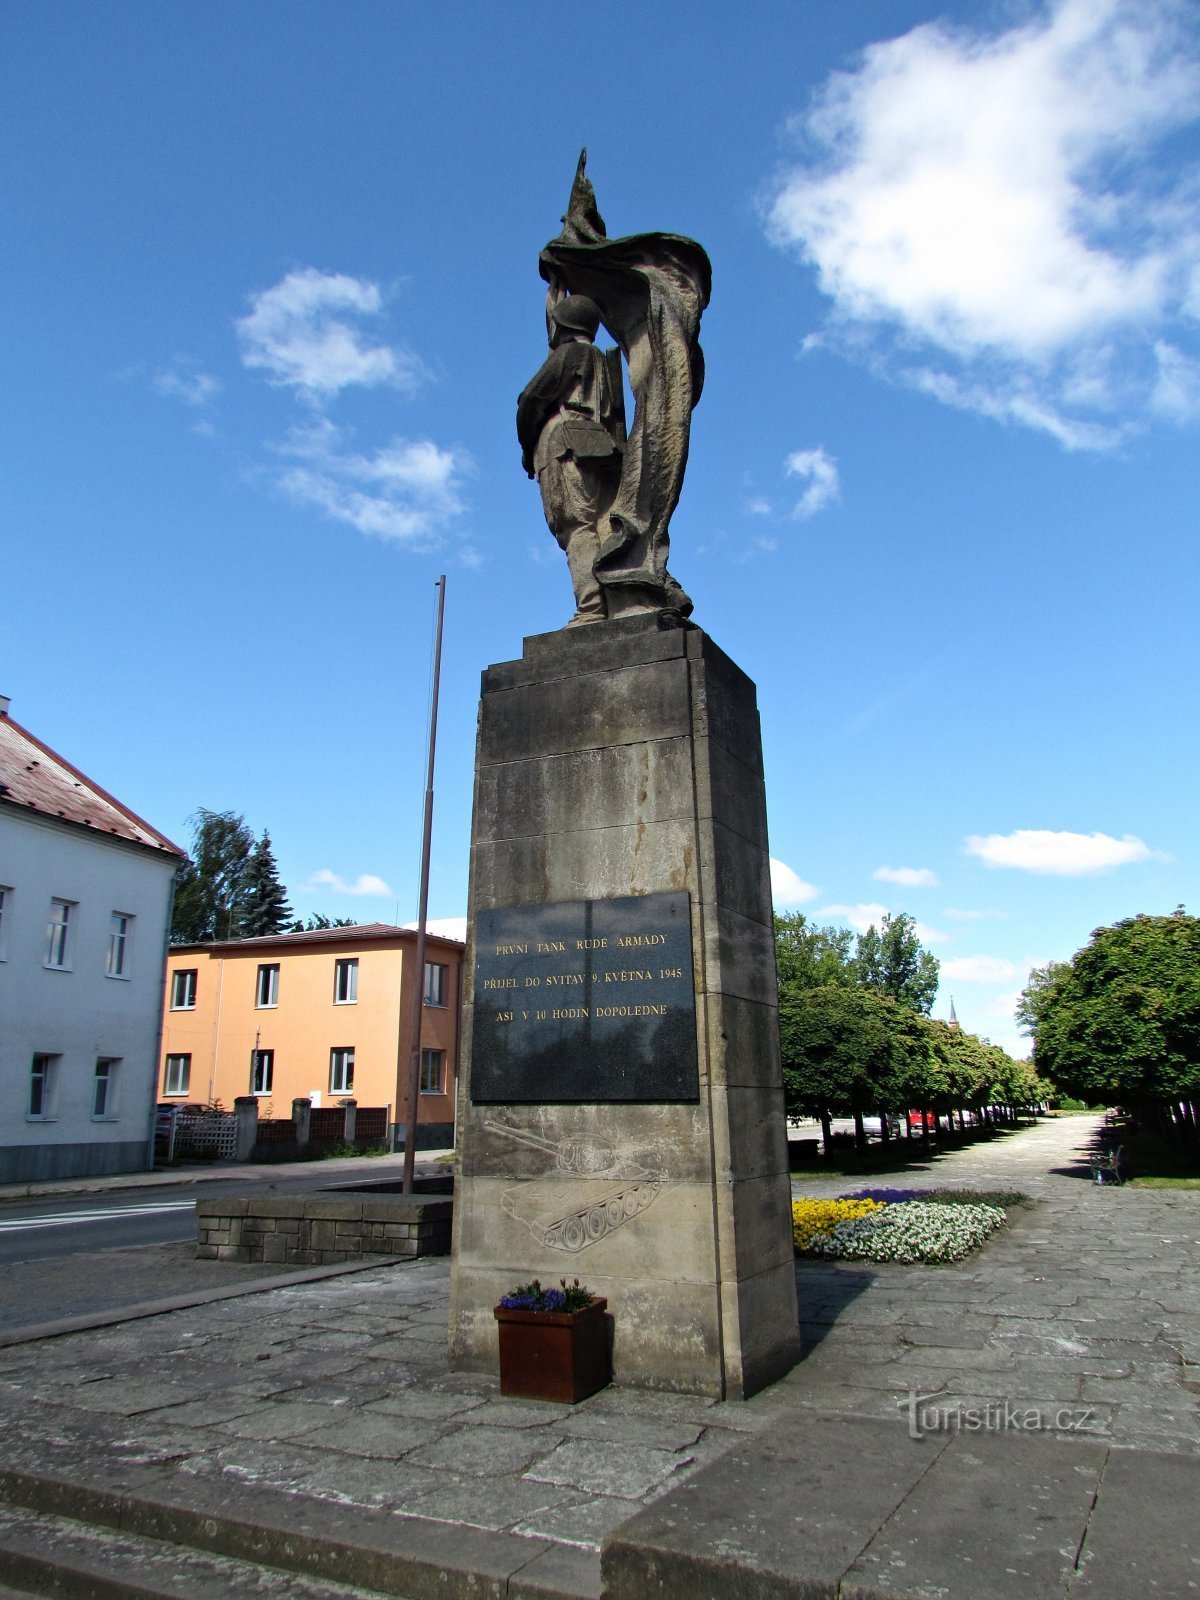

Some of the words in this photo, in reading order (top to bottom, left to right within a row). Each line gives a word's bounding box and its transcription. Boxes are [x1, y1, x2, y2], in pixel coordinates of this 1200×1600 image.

[537, 941, 566, 952] TANK
[576, 936, 608, 950] RUDÉ
[617, 933, 668, 947] ARMÁDY
[484, 977, 519, 989] PŘIJEL
[525, 976, 540, 987] DO
[546, 974, 586, 986] SVITAV
[592, 973, 601, 983] 9.
[604, 970, 653, 982] KVĚTNA
[660, 968, 683, 979] 1945
[496, 1011, 514, 1022] ASI
[522, 1010, 530, 1020] V
[536, 1009, 546, 1020] 10
[552, 1007, 589, 1018] HODIN
[595, 1004, 668, 1017] DOPOLEDNE
